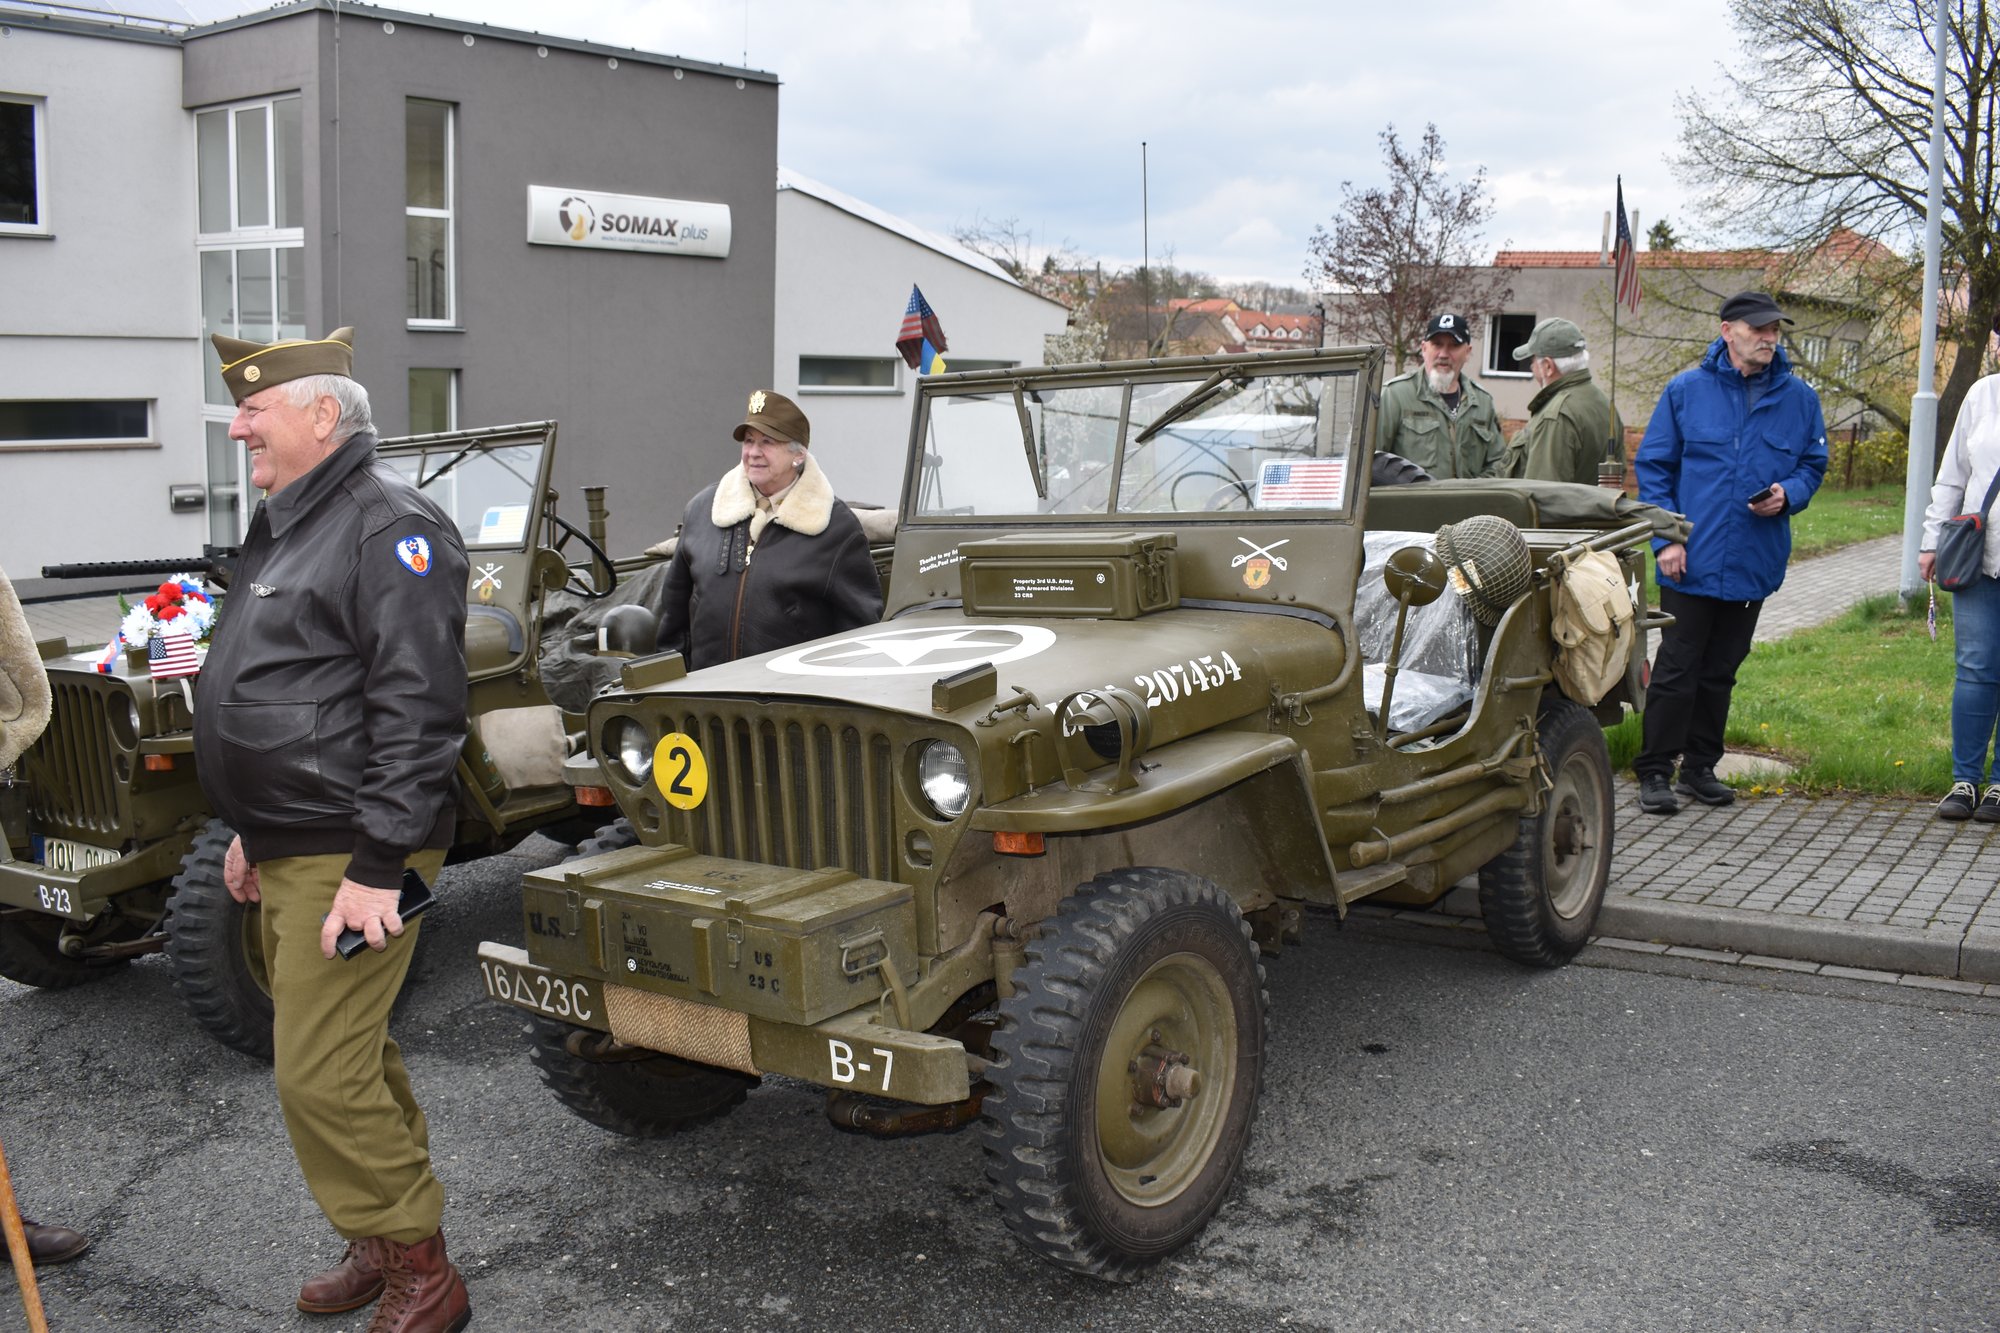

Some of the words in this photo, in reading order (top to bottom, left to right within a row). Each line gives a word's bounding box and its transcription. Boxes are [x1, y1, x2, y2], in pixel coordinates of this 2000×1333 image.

[601, 213, 678, 237] SOMAX
[680, 224, 709, 242] plus
[413, 555, 425, 571] 9
[1134, 651, 1242, 709] 207454
[669, 746, 693, 796] 2
[39, 884, 72, 914] B-23
[528, 911, 566, 939] U.S.
[754, 950, 773, 968] US
[828, 1038, 893, 1091] B-7
